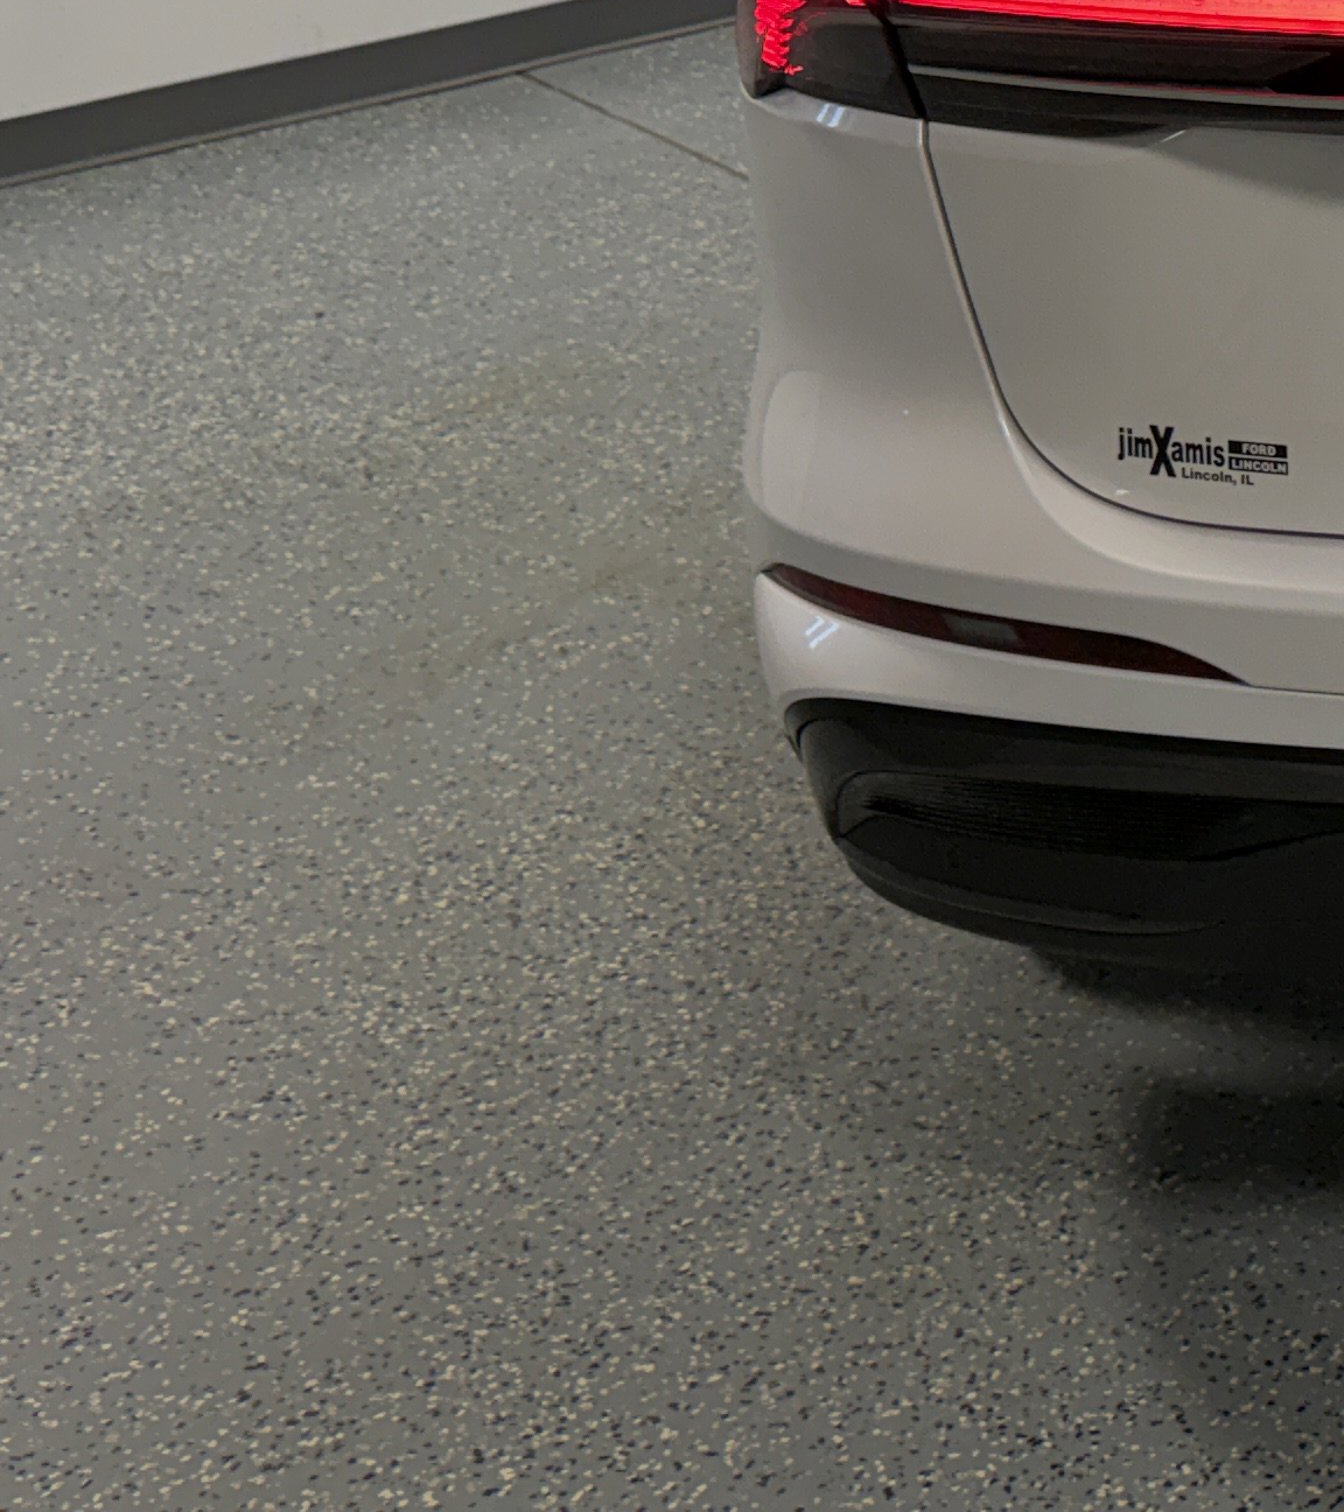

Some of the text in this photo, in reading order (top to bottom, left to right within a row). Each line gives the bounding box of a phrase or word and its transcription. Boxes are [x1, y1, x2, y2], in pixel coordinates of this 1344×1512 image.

[1242, 443, 1277, 456] FORD
[1231, 459, 1287, 473] LINCOLN
[1181, 467, 1254, 486] Lincoln, IL
